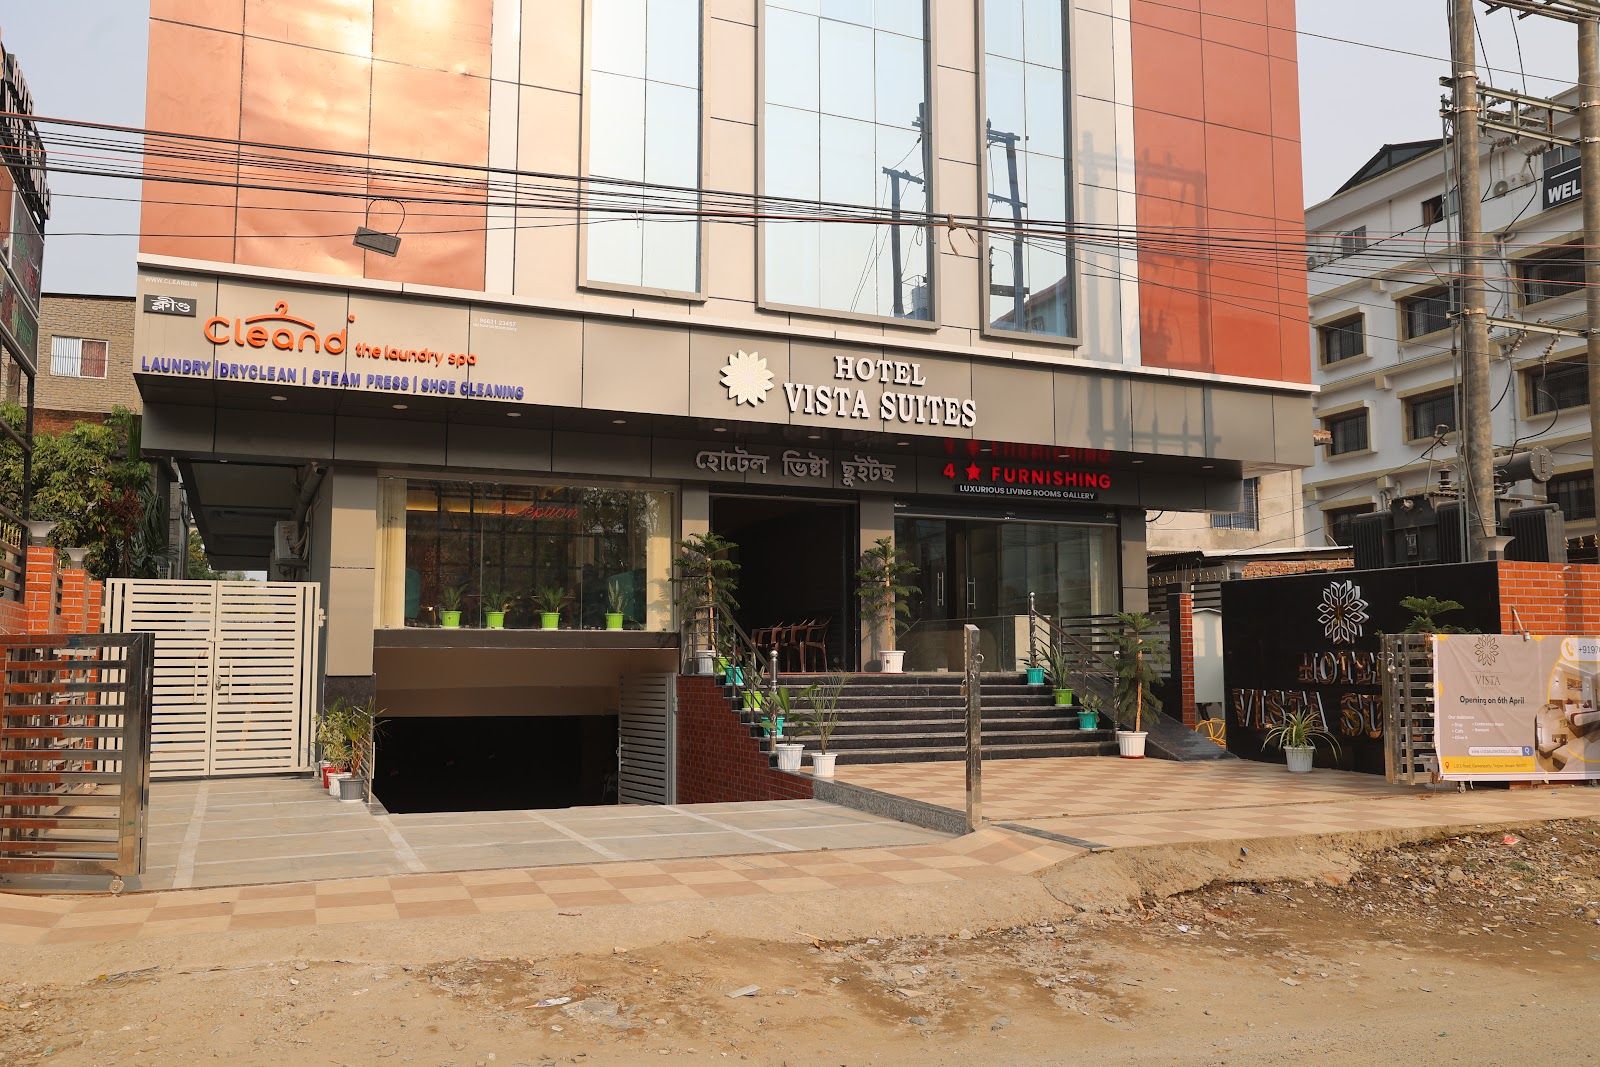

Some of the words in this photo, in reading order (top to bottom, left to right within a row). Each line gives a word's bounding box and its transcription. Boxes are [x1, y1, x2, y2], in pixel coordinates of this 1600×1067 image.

[355, 341, 382, 359] the
[384, 345, 445, 368] laundry
[447, 350, 478, 369] spa
[141, 356, 211, 376] LAUNDRY
[311, 370, 361, 389] STEAM
[366, 373, 409, 391] PRESS
[420, 378, 456, 395] SHOE
[459, 381, 525, 400] CLEANING
[834, 355, 927, 387] HOTEL
[783, 382, 872, 419] VISTA
[880, 391, 978, 428] SUITES
[943, 462, 956, 480] 4
[991, 466, 1112, 490] FURNISHING
[959, 485, 1005, 495] LUXURIOUS
[1006, 487, 1033, 497] LIVING
[1033, 489, 1062, 498] ROOMS
[1063, 491, 1095, 500] GALLERY
[1297, 651, 1382, 685] HOTE
[1473, 673, 1501, 686] VISTA
[1459, 694, 1487, 706] Opening
[1487, 697, 1497, 705] on
[1497, 695, 1508, 705] 6th
[1509, 696, 1525, 707] April
